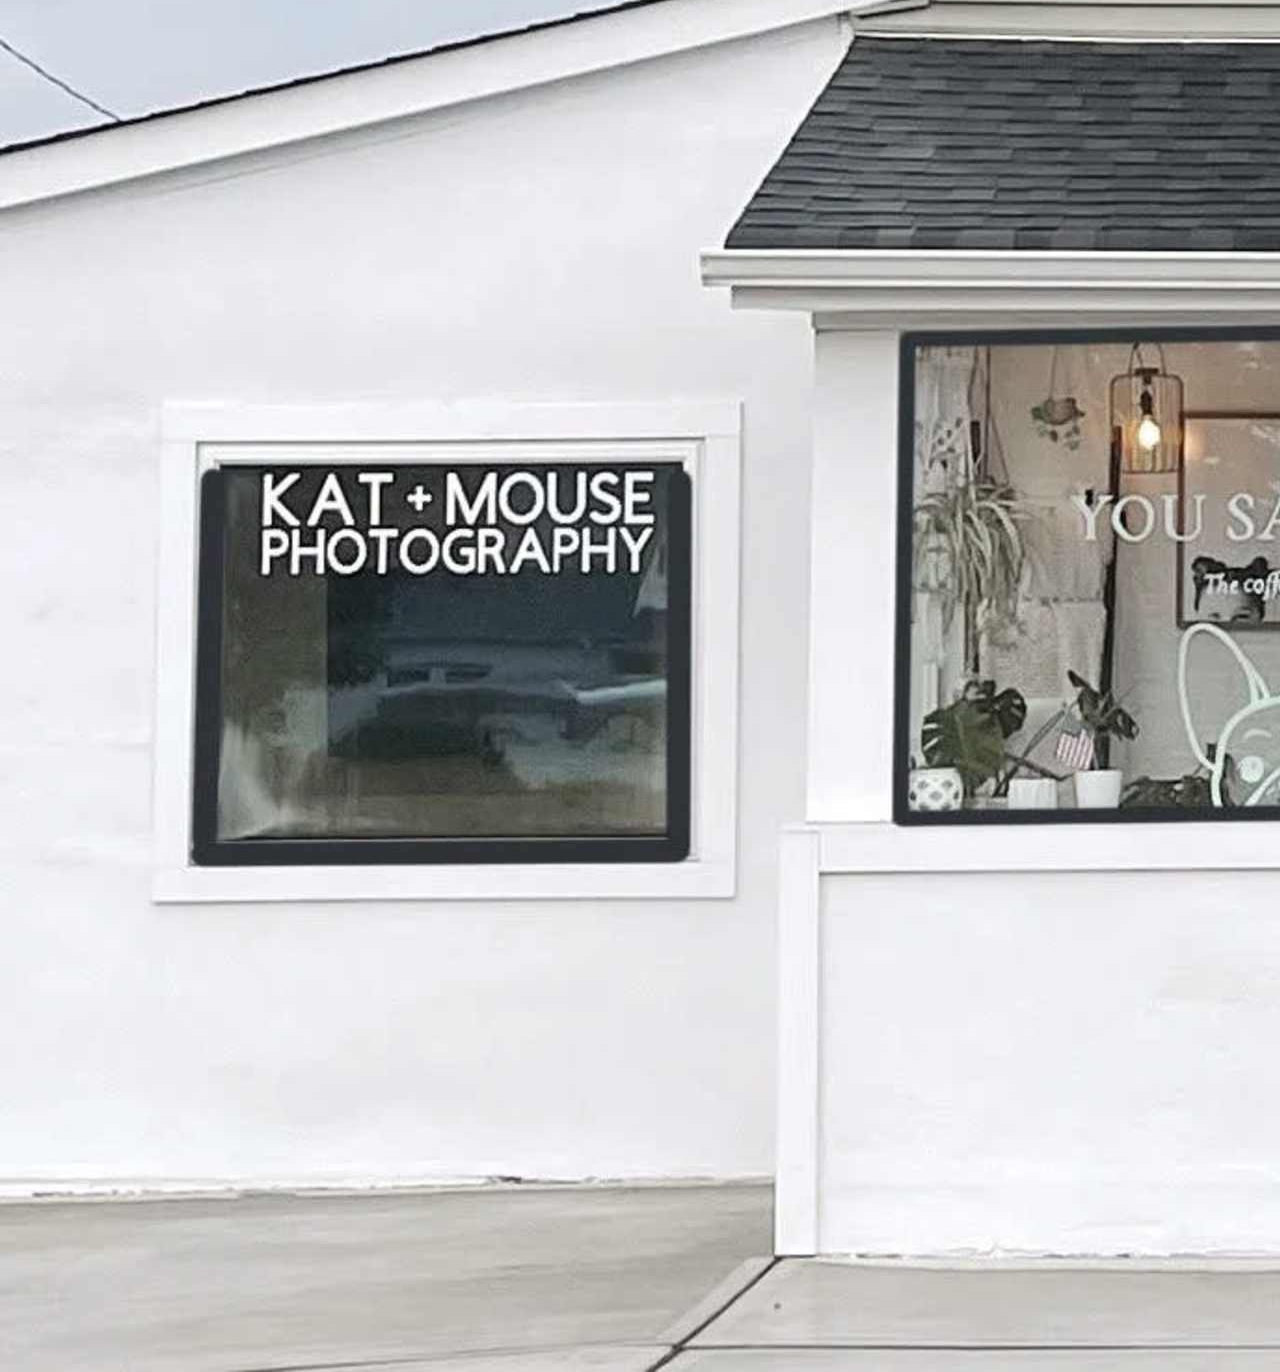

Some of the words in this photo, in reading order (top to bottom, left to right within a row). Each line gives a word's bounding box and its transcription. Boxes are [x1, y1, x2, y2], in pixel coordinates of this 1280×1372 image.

[261, 472, 394, 527] KAT
[445, 471, 655, 526] MOUSE
[1070, 492, 1206, 543] YOU
[260, 527, 655, 576] PHOTOGRAPHY
[1203, 573, 1239, 595] The
